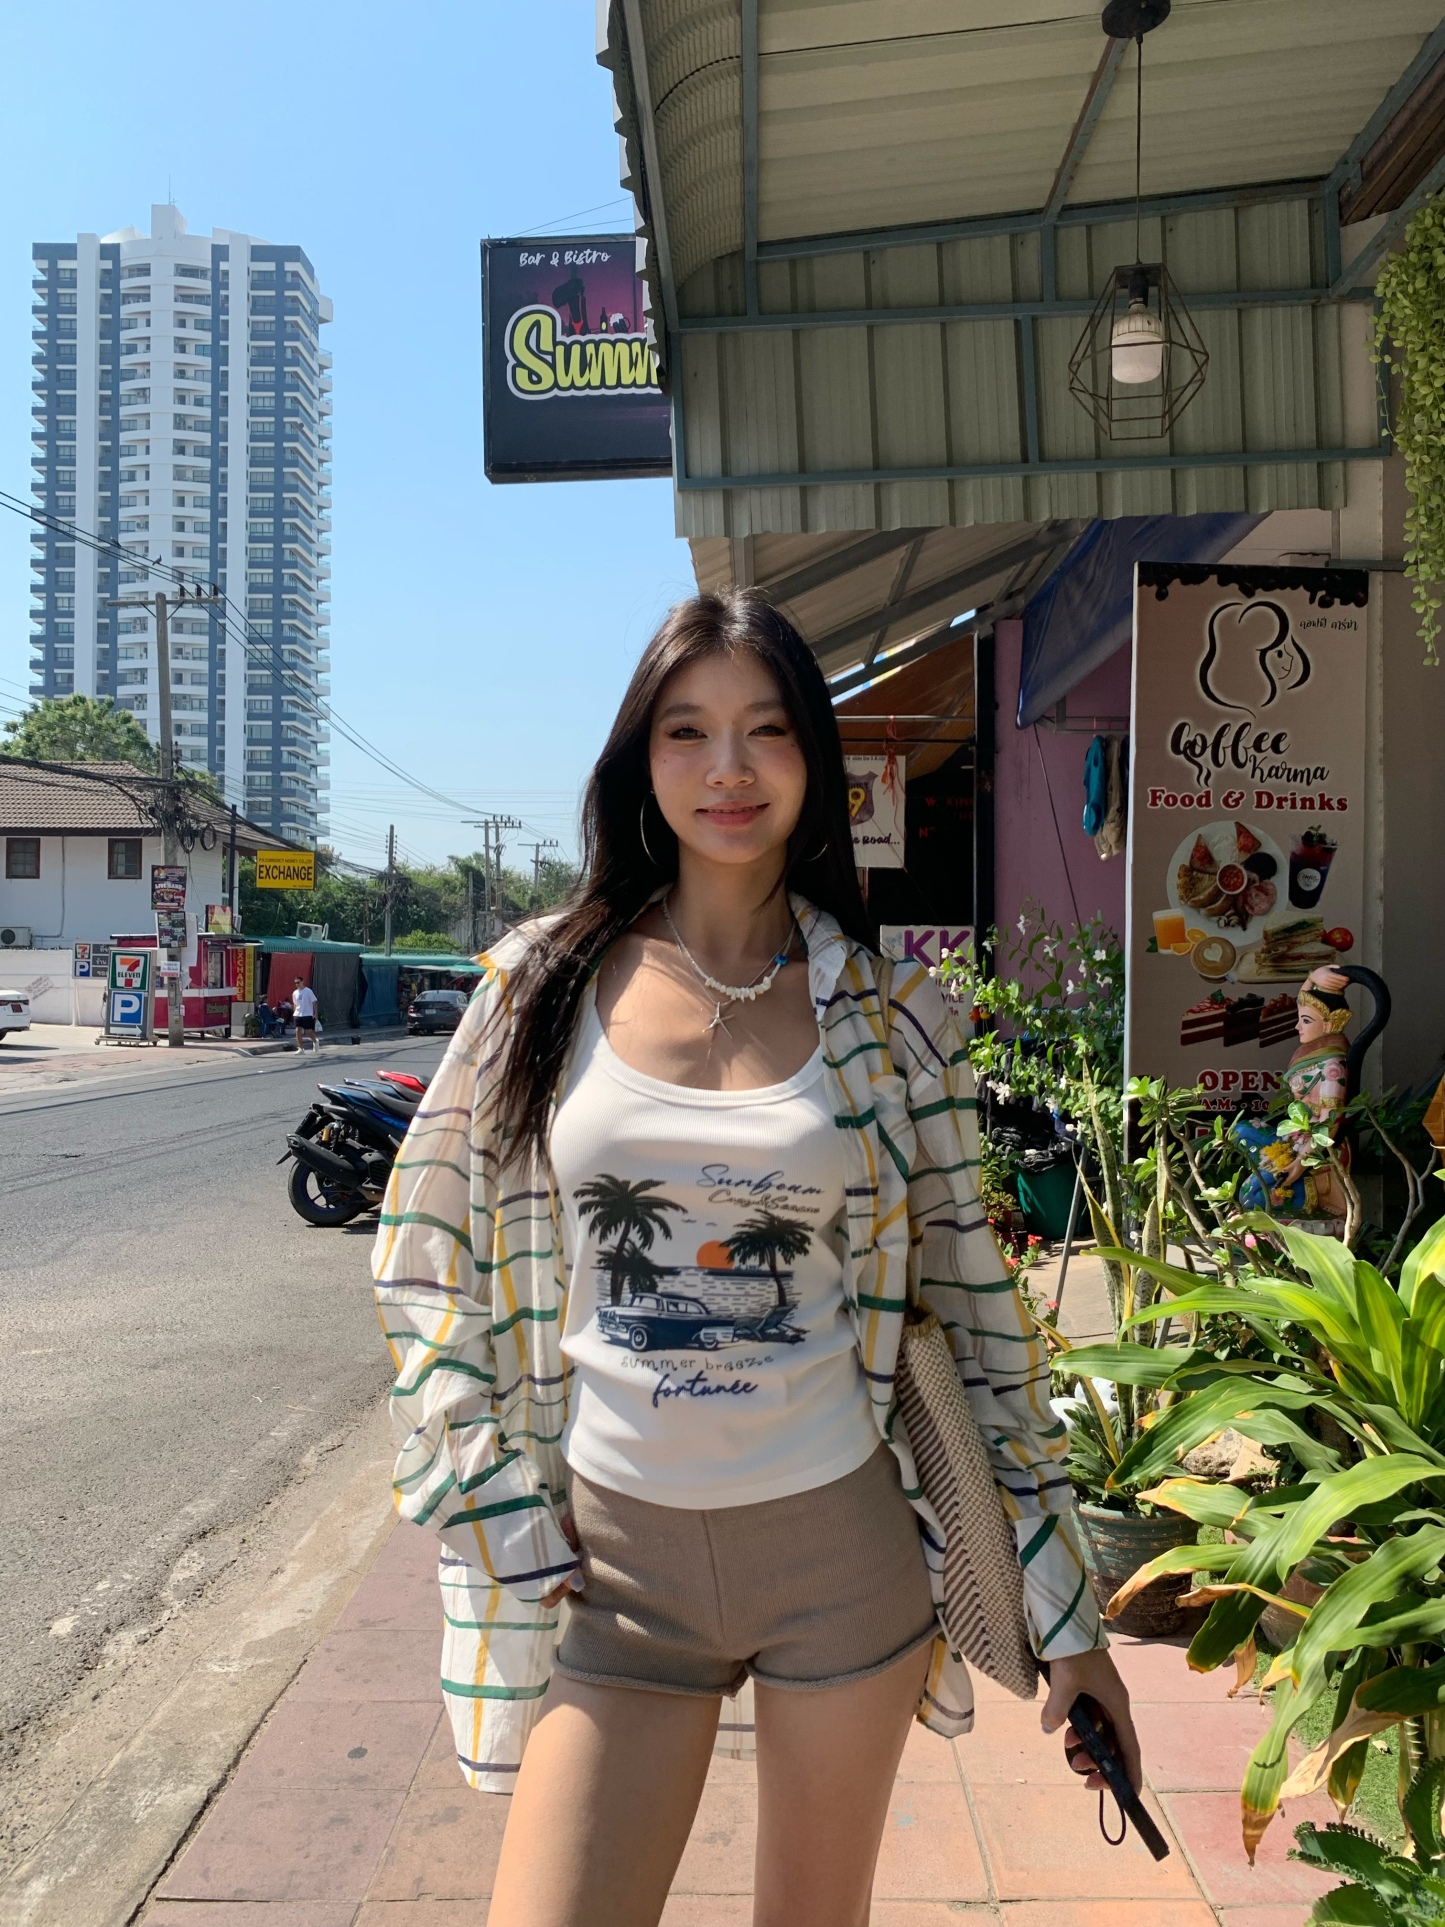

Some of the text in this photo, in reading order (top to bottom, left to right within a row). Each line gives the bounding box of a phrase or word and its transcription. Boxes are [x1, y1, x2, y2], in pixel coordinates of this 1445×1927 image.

[519, 248, 612, 267] Bar & Bistro
[1170, 721, 1290, 770] Coffee
[1249, 754, 1330, 786] Karma
[1148, 788, 1348, 811] Food & Drinks
[258, 864, 313, 881] EXCHANGE
[75, 961, 89, 977] P
[119, 957, 141, 988] 7
[113, 993, 140, 1021] P
[1198, 1070, 1283, 1092] OPEN
[1201, 1098, 1237, 1112] A.M.
[696, 1163, 825, 1196] Sunbeam
[620, 1354, 774, 1371] summer breeze
